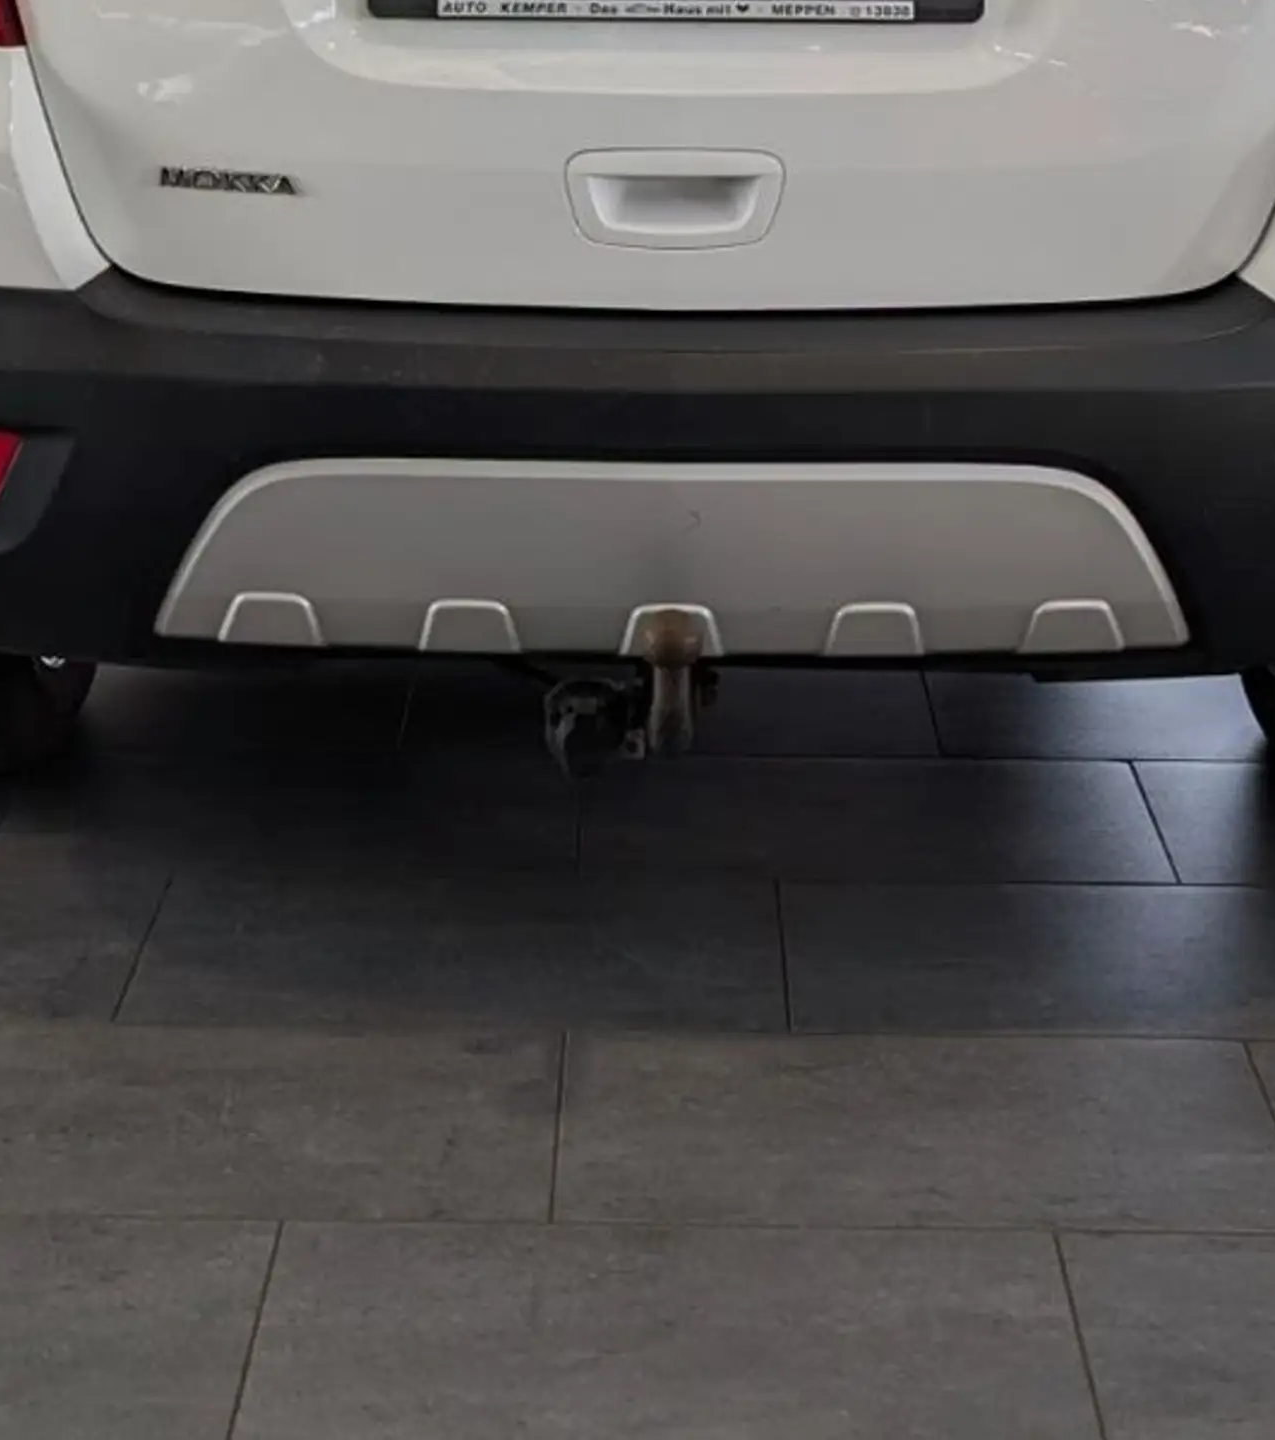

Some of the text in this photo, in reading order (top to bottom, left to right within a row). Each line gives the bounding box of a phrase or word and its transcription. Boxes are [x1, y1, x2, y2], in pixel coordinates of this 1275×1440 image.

[442, 0, 487, 14] AUTO
[501, 1, 568, 14] KEMPER
[771, 3, 836, 17] MEPPEN
